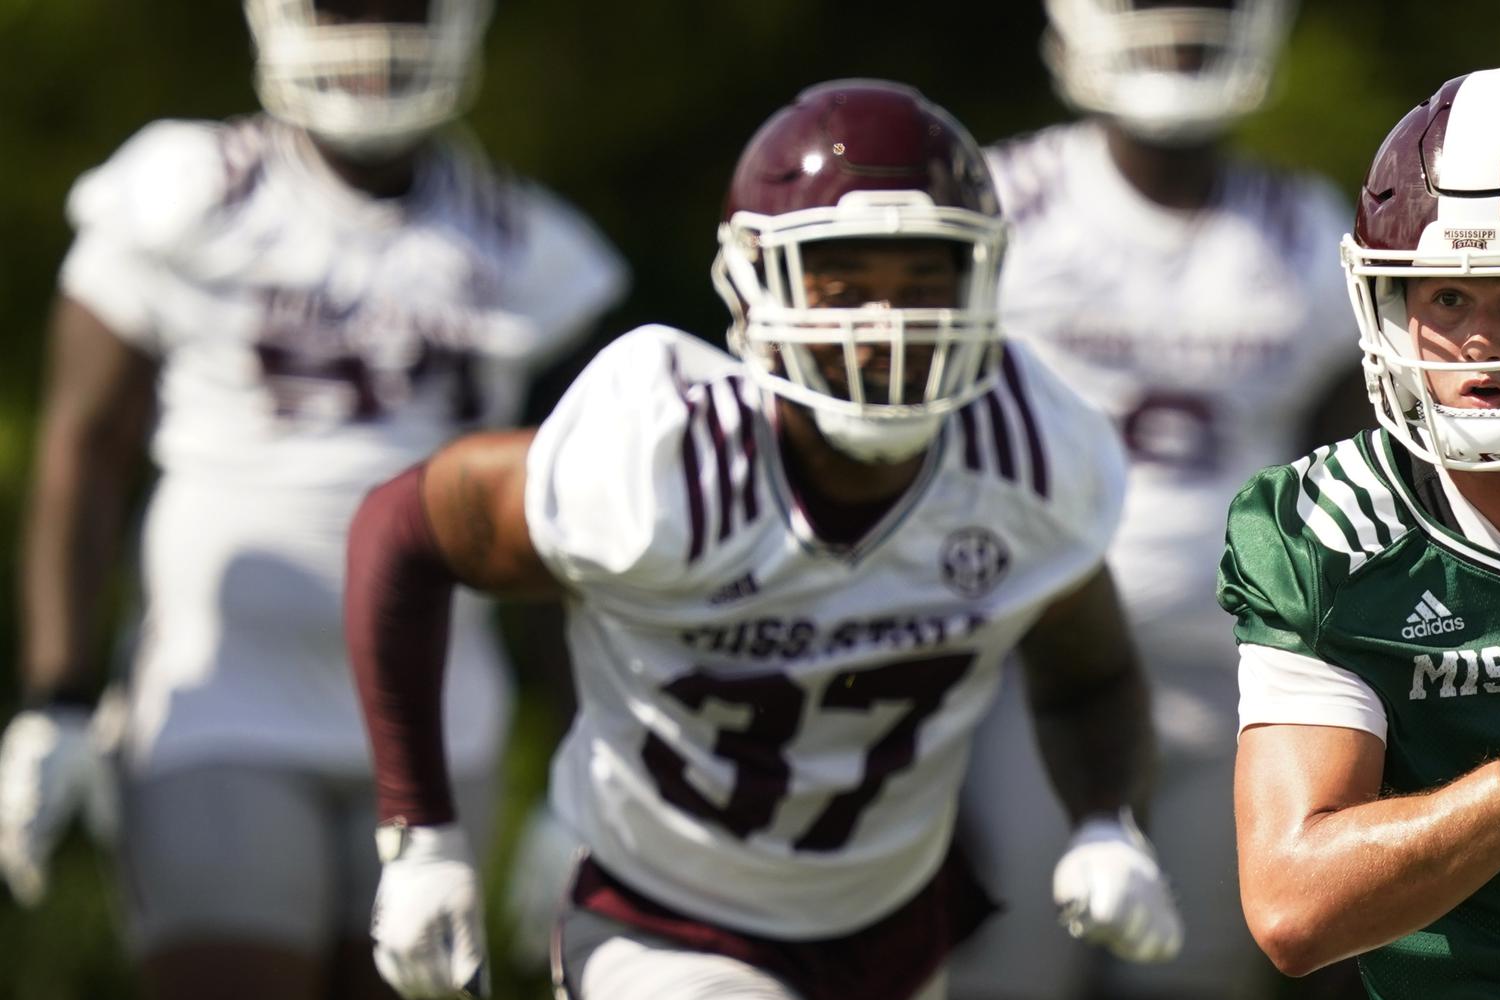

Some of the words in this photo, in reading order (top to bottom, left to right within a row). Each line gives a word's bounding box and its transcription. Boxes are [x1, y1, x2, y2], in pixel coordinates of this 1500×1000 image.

[1444, 230, 1496, 239] MISSISSIPPI
[1456, 240, 1483, 248] STATE
[1401, 615, 1465, 638] adidas
[641, 652, 977, 853] 37
